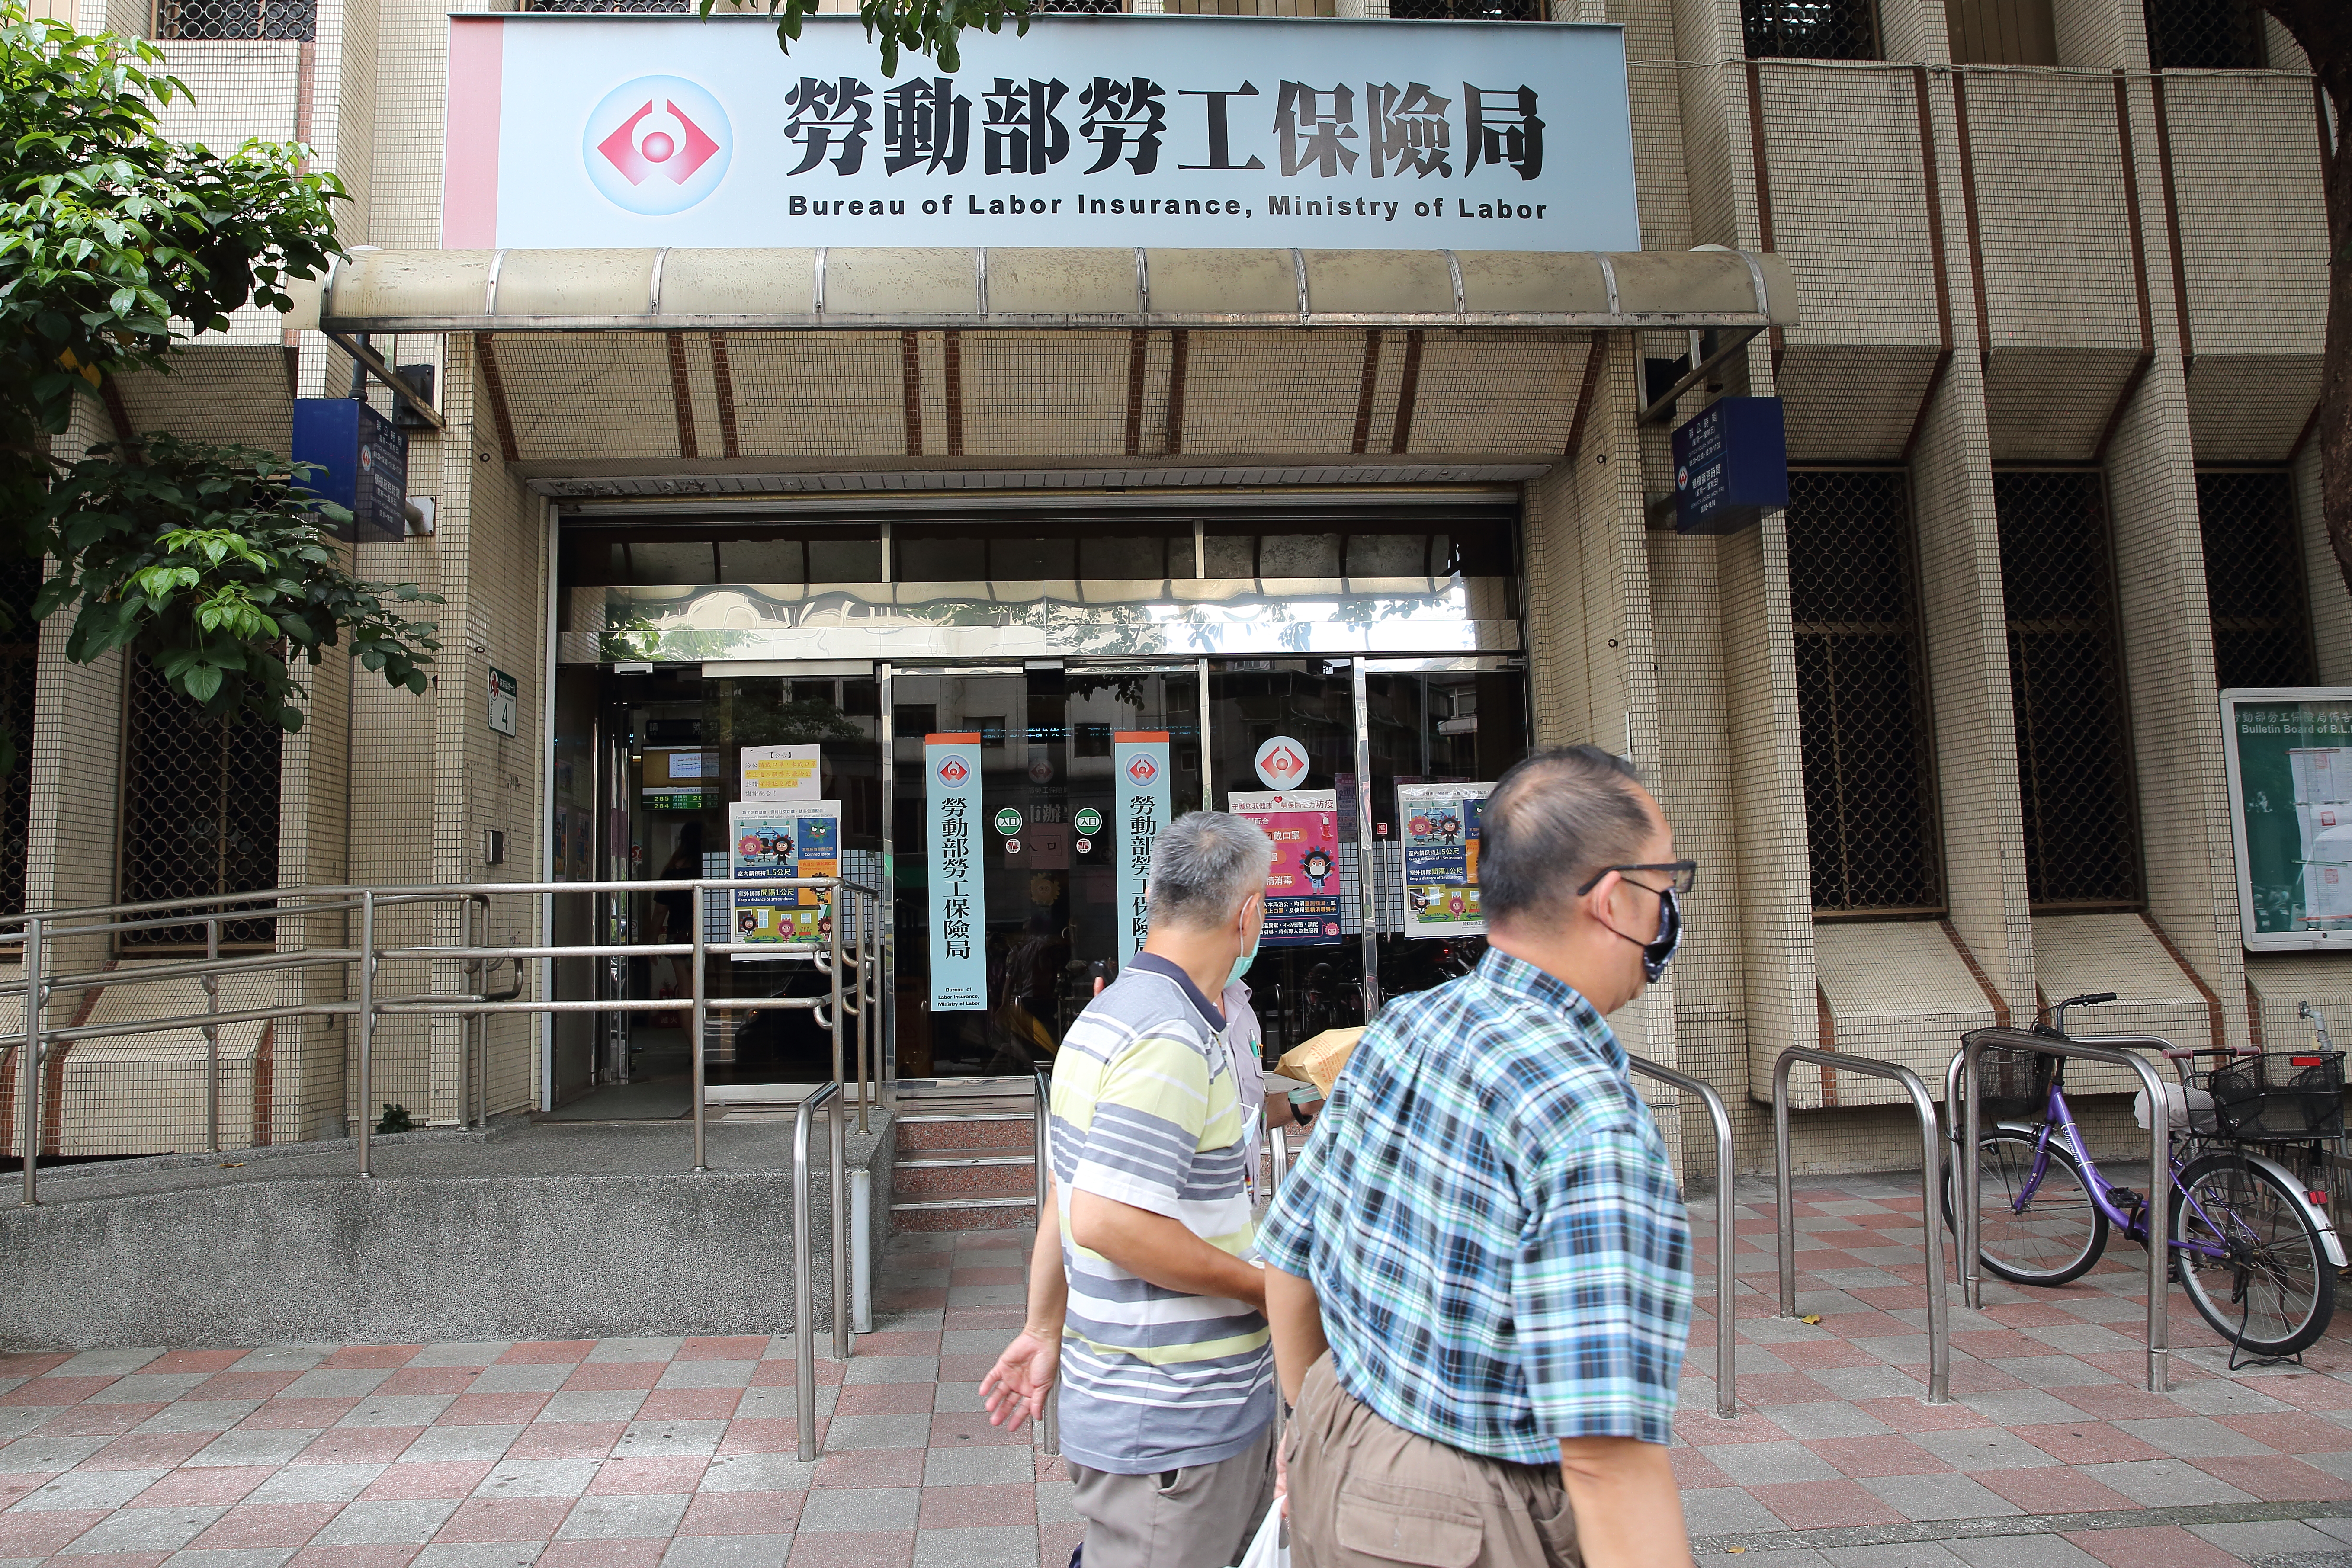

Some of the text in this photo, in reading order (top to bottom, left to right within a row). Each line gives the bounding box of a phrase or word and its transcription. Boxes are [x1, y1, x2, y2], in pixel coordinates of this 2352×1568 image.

[785, 76, 1546, 181] 勞動部勞工保險局
[790, 195, 1547, 221] Bureau of Labor Insurance, Ministry of Labor
[502, 703, 508, 730] 4
[649, 723, 658, 732] 請
[2242, 725, 2281, 733] Bulletin
[2284, 725, 2314, 733] Board
[2317, 725, 2328, 733] of
[1280, 799, 1334, 809] 勞保局全力防疫
[1001, 818, 1017, 826] 入口
[1080, 818, 1097, 826] 入口
[1273, 831, 1300, 840] 戴口罩
[1408, 848, 1460, 856] 室內請保持1.5公尺
[737, 868, 791, 877] 室內請保持1.5公尺
[1409, 867, 1463, 875] 室外排隊間隔1公尺
[941, 797, 971, 960] 勞動部勞工保險局
[738, 888, 795, 897] 室外排隊間隔1公尺
